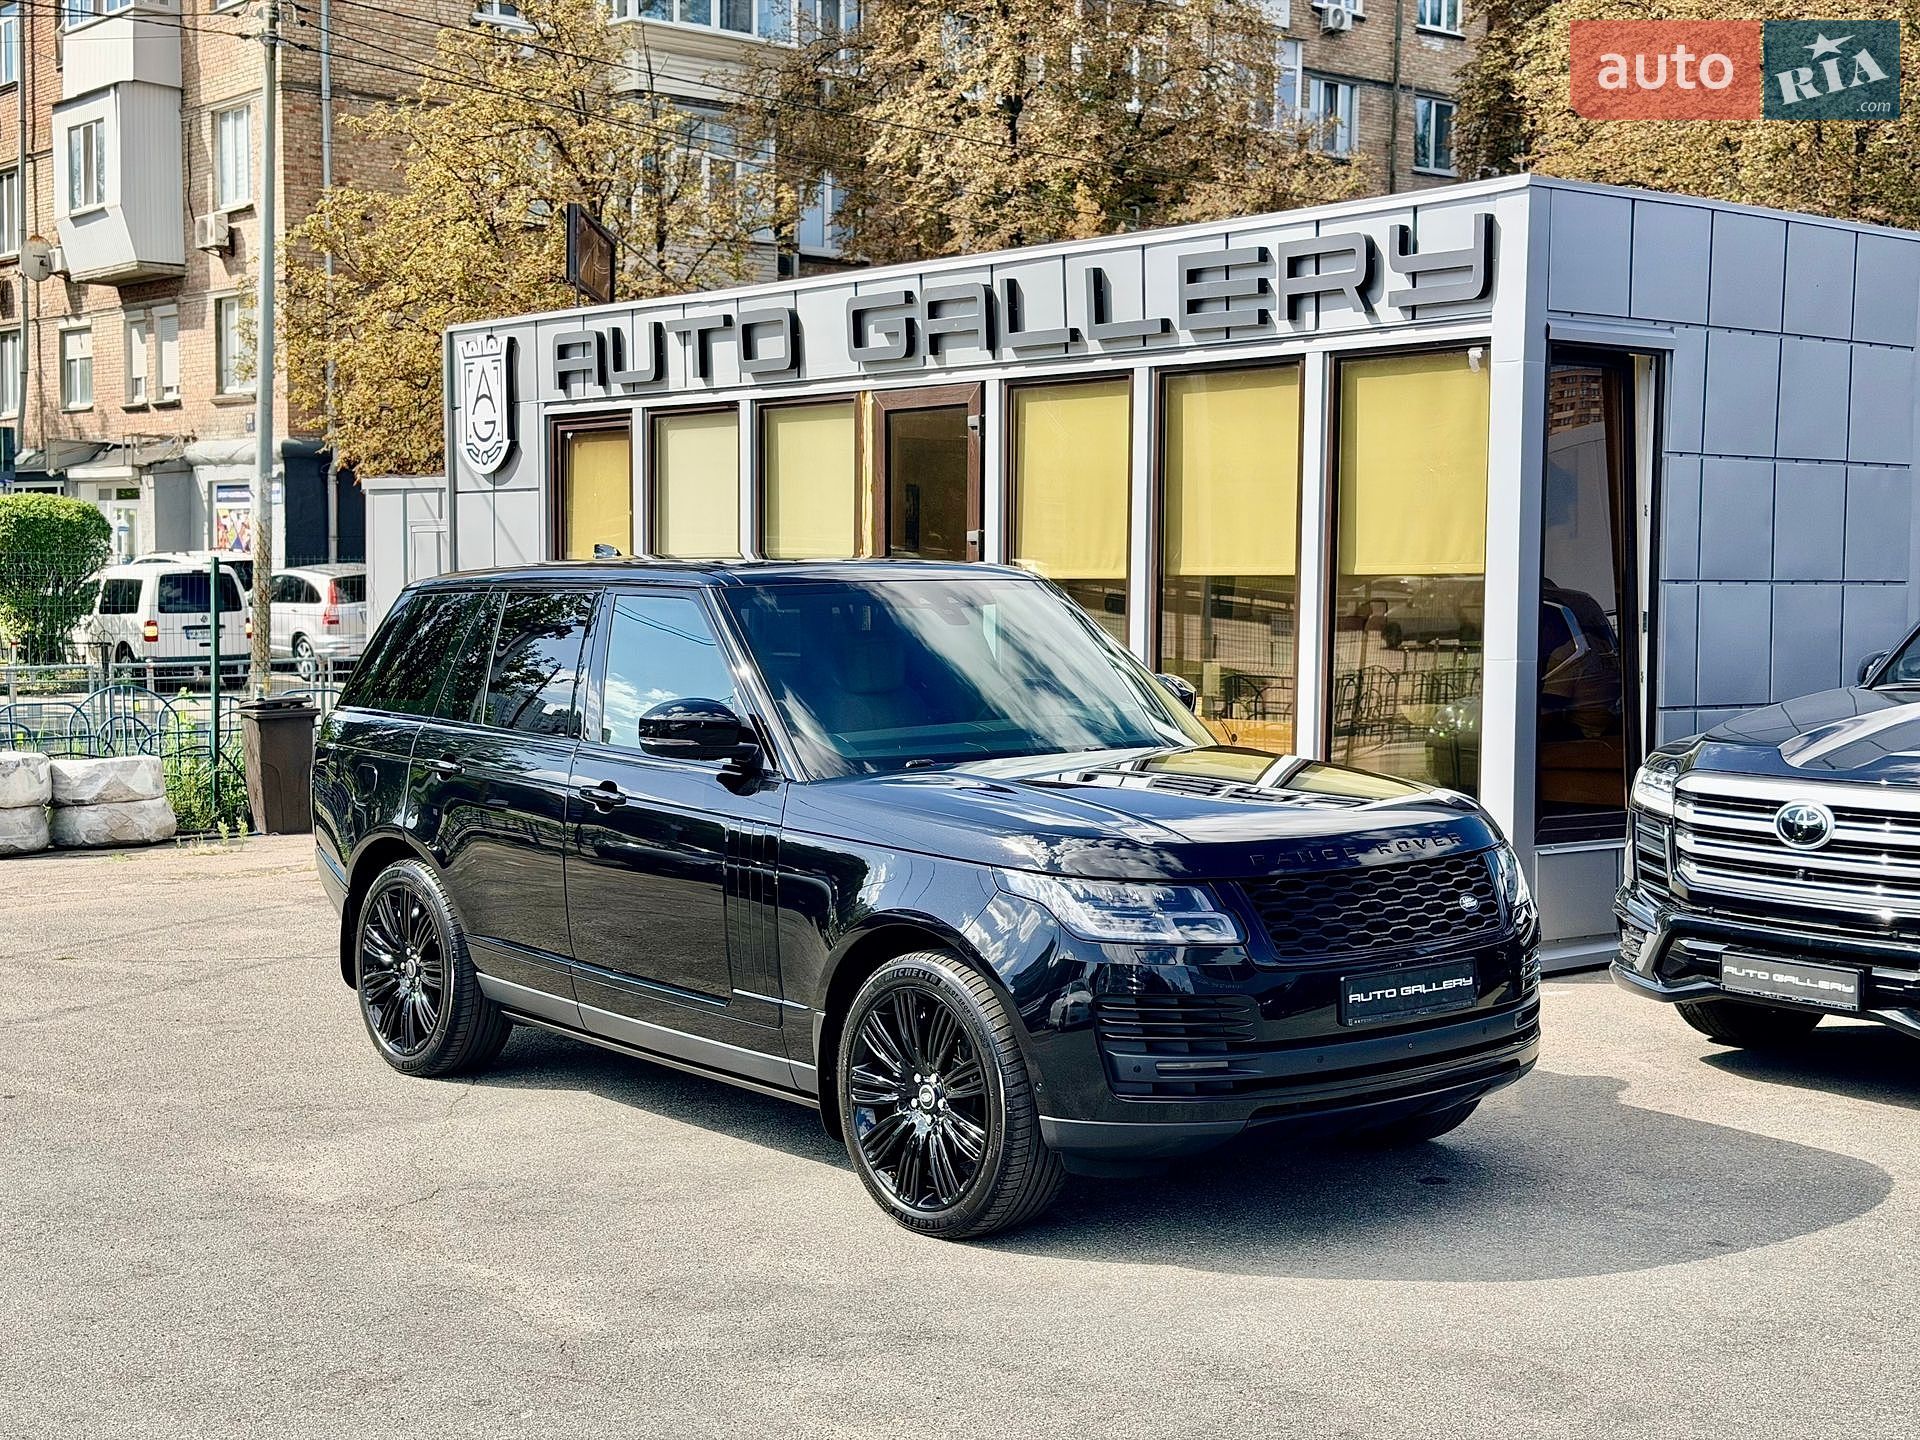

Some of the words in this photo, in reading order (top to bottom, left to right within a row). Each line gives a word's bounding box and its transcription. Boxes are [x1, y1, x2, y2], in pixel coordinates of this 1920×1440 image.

[552, 307, 800, 391] AUTO
[846, 213, 1499, 362] GALLERY
[1376, 832, 1464, 855] ROVER
[1348, 988, 1397, 1003] AUTO
[1400, 976, 1473, 996] GALLERY
[1723, 965, 1769, 980] AUTO
[1772, 974, 1855, 993] GALLERY
